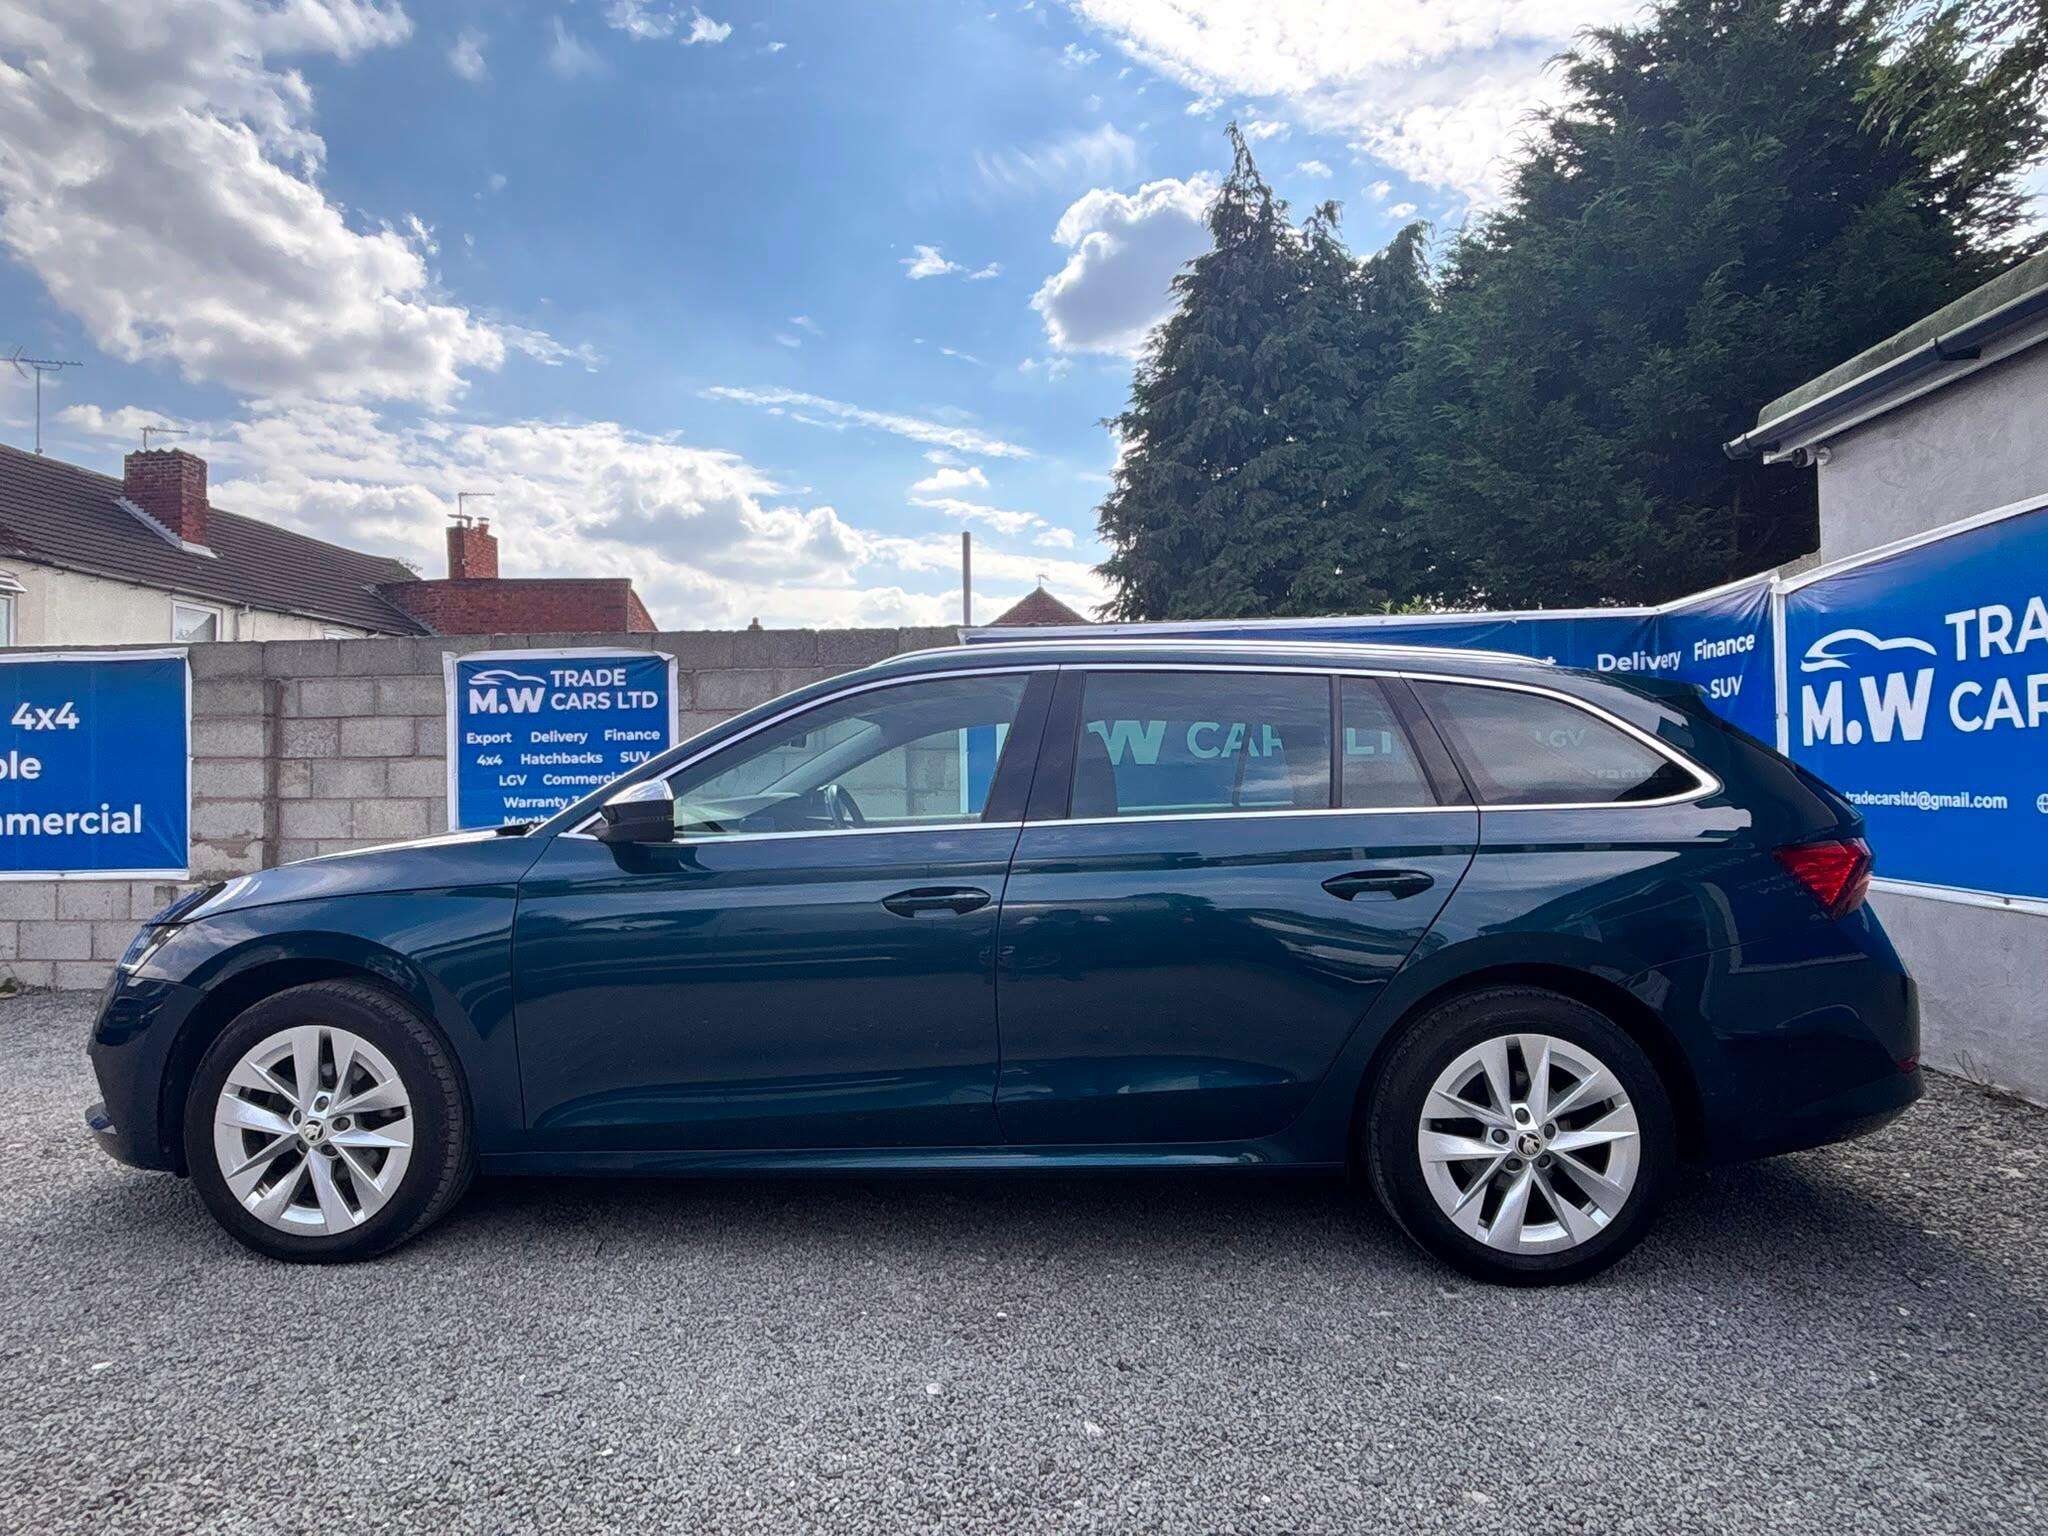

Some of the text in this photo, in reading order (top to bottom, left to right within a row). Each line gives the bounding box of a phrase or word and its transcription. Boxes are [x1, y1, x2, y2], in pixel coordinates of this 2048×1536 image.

[1597, 634, 1755, 671] Delivery Finance
[550, 669, 627, 687] TRADE
[1710, 675, 1743, 699] SUV
[469, 687, 546, 714] M.W
[551, 691, 658, 711] CARS LTD
[1802, 667, 1934, 747] M.W
[11, 702, 80, 730] 4x4
[466, 729, 661, 746] Export Delivery Finance
[476, 751, 651, 766] 4x4 Hatchbacks SUV
[499, 772, 620, 786] LGV Commerci
[503, 796, 568, 810] Warranty
[0, 803, 142, 836] mercial
